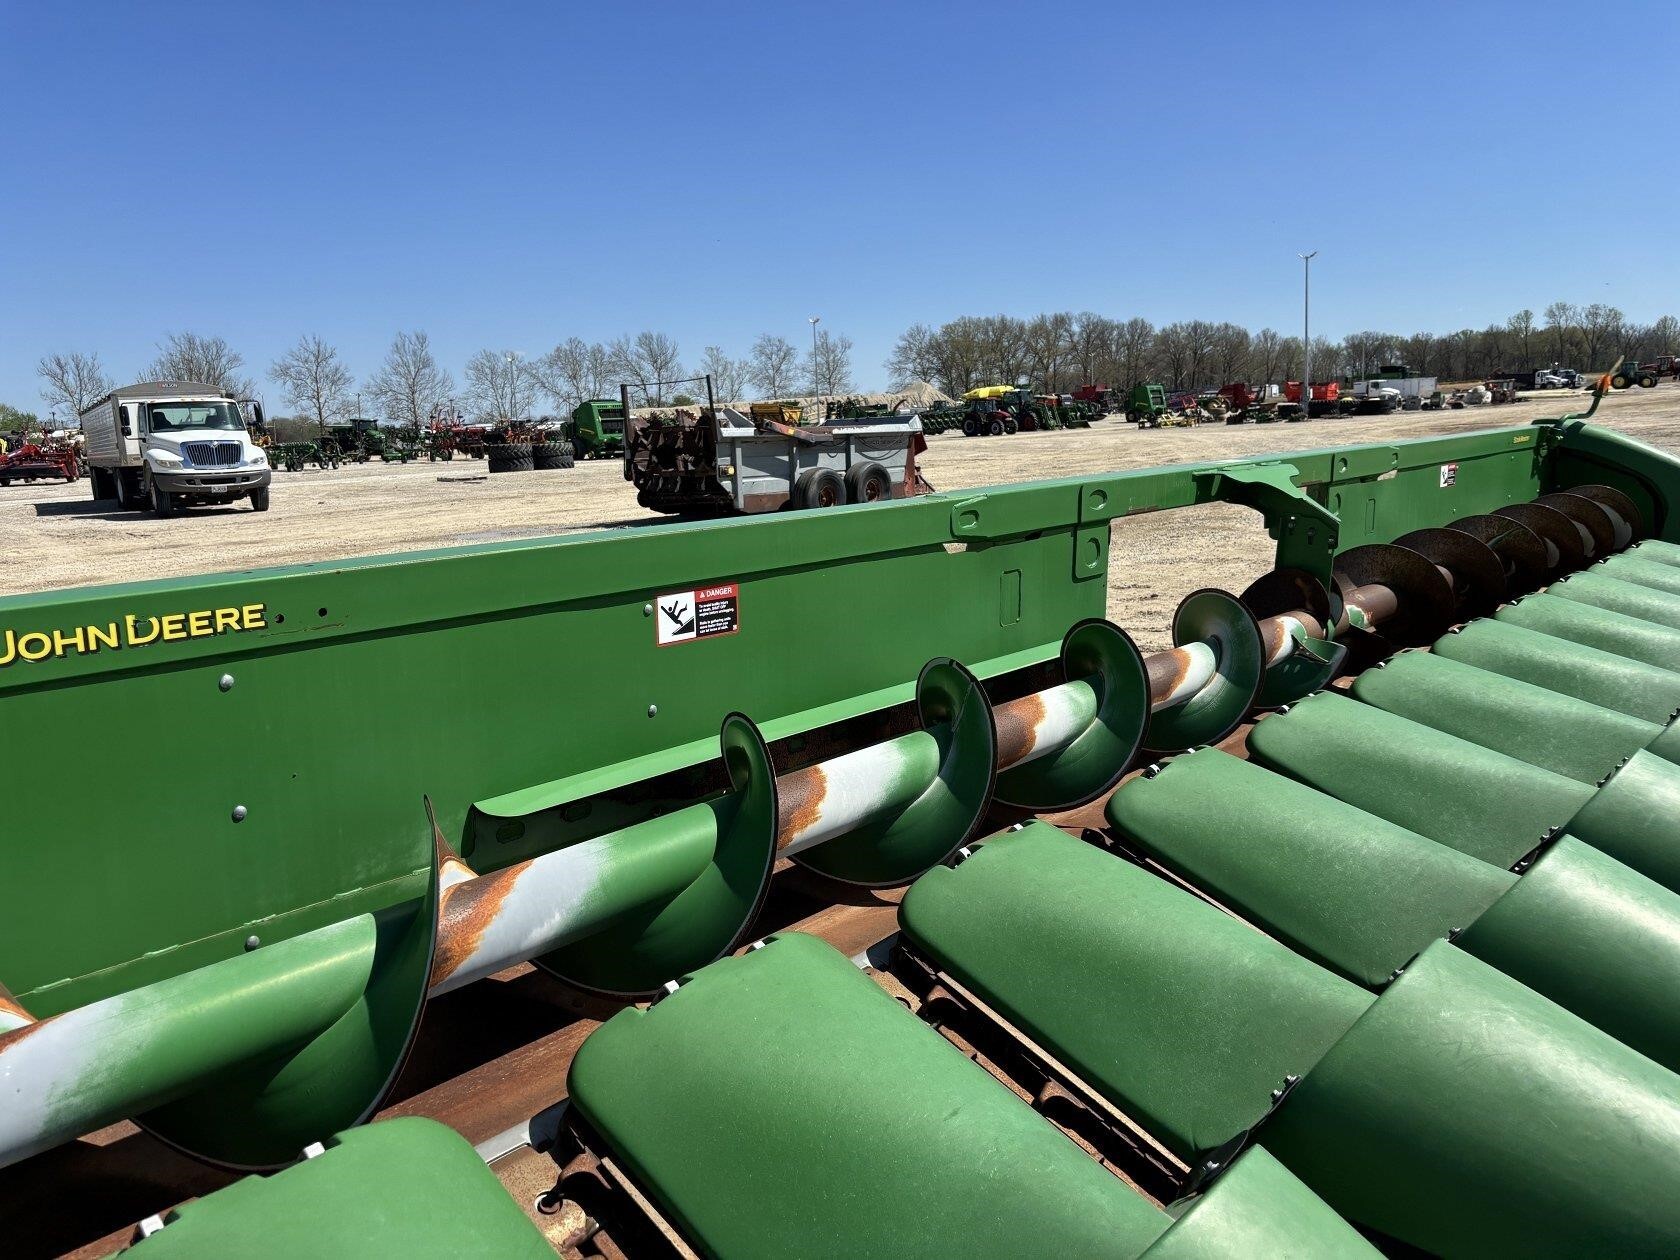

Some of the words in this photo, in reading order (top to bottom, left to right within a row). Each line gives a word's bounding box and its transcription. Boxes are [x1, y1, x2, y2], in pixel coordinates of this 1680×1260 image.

[706, 587, 732, 597] DANGER
[0, 622, 119, 665] JOHN
[125, 603, 266, 646] DEERE
